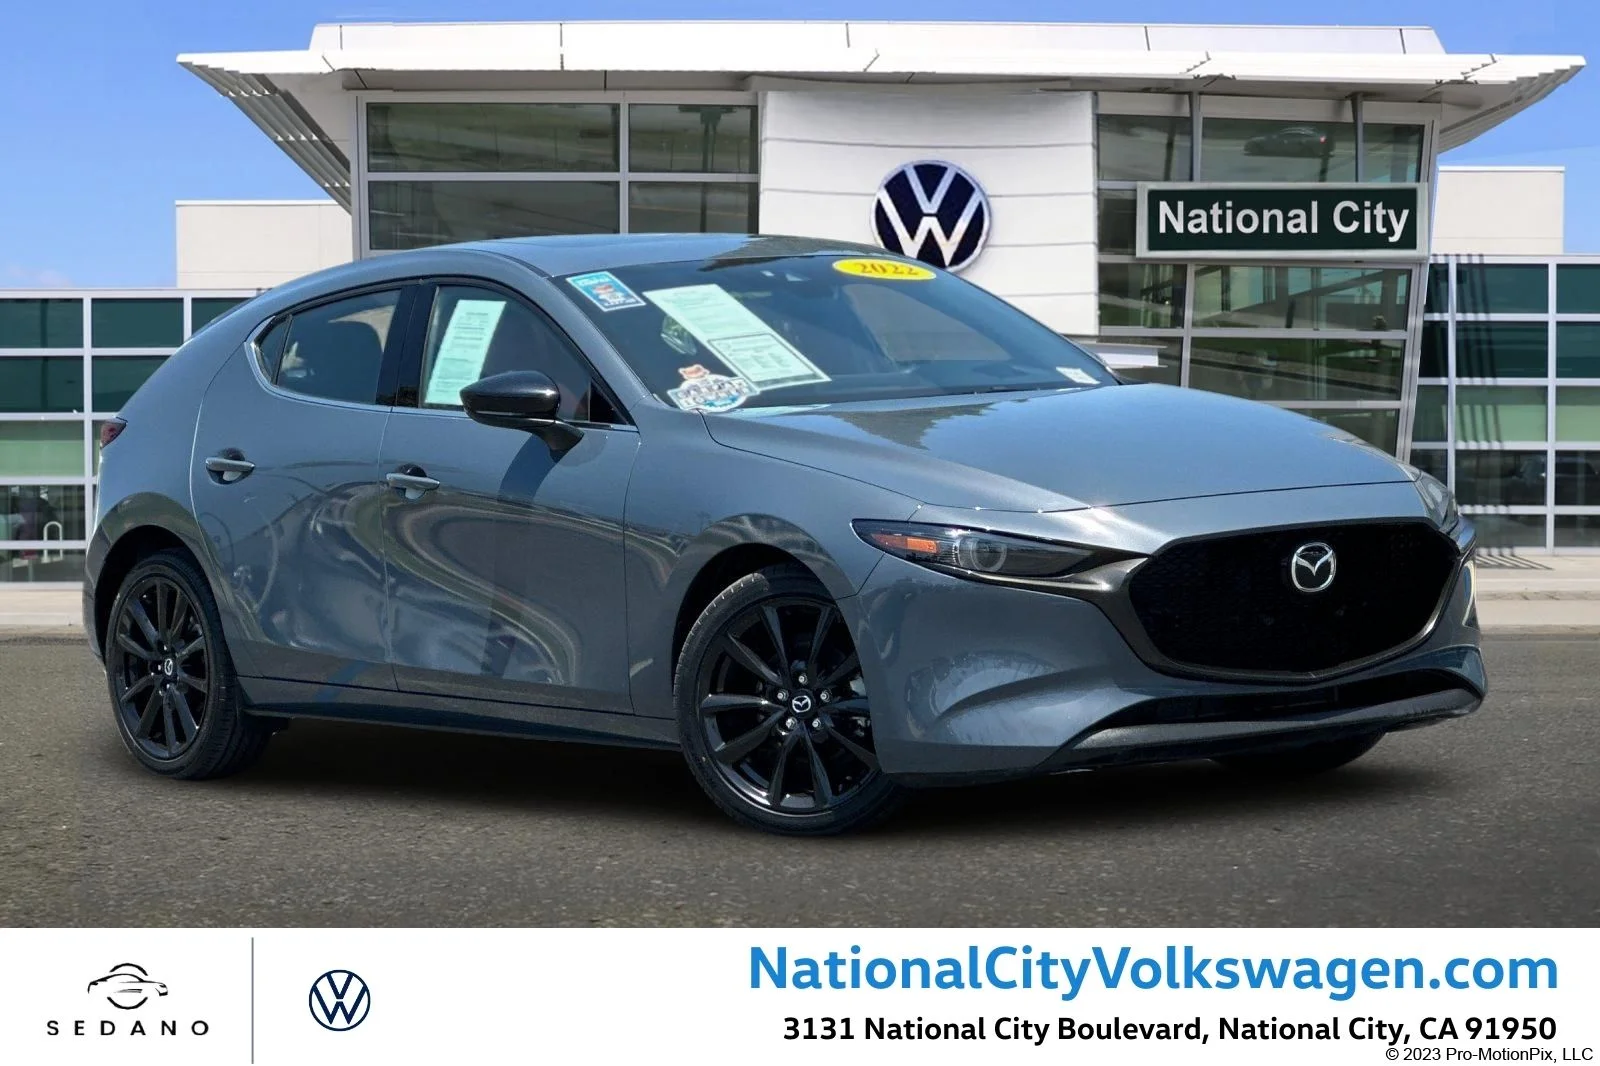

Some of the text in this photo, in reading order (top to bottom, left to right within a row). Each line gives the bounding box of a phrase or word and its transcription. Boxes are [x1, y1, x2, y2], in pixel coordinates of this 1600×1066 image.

[1158, 200, 1411, 243] National City
[854, 260, 921, 278] 2022
